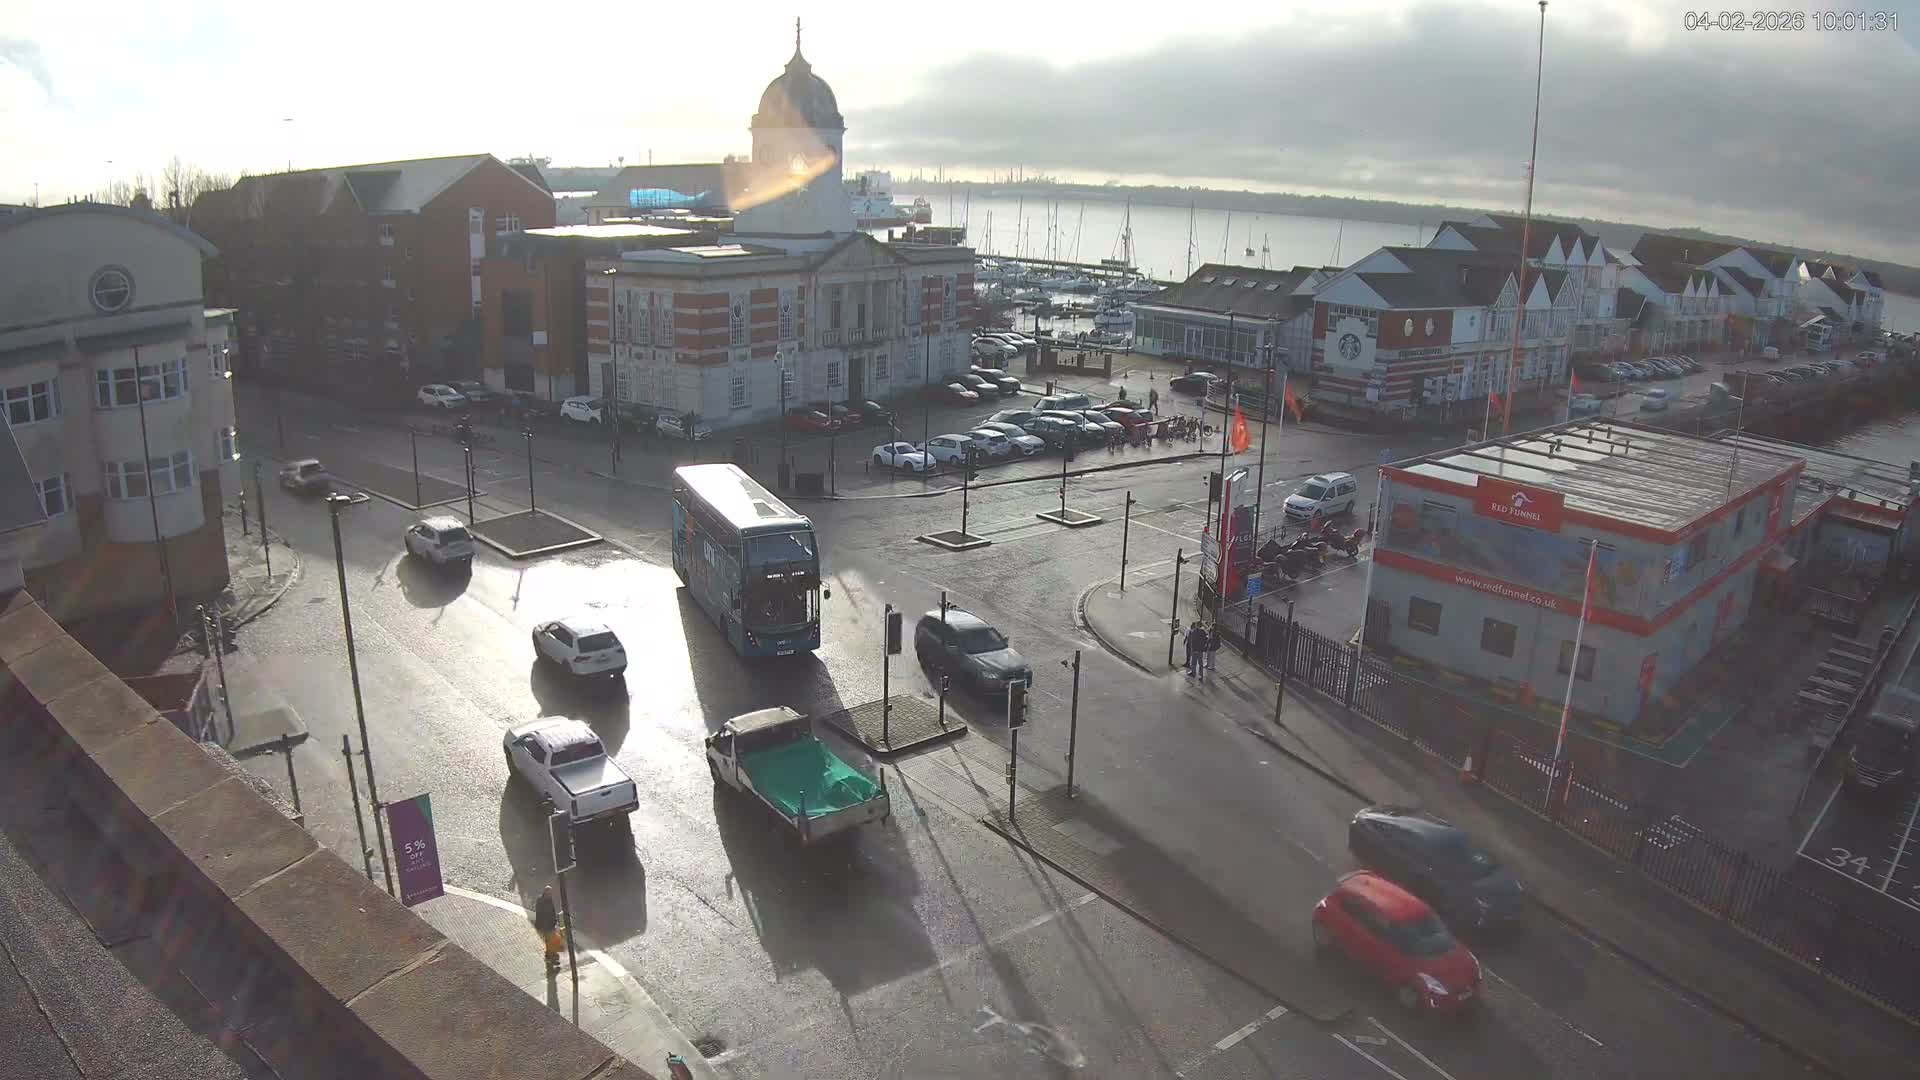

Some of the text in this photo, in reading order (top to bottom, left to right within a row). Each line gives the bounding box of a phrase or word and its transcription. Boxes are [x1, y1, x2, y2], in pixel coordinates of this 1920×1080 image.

[1491, 502, 1541, 521] RED FUNNEL
[1455, 575, 1557, 609] www.redfunnel.co.uk
[1825, 847, 1871, 875] 34
